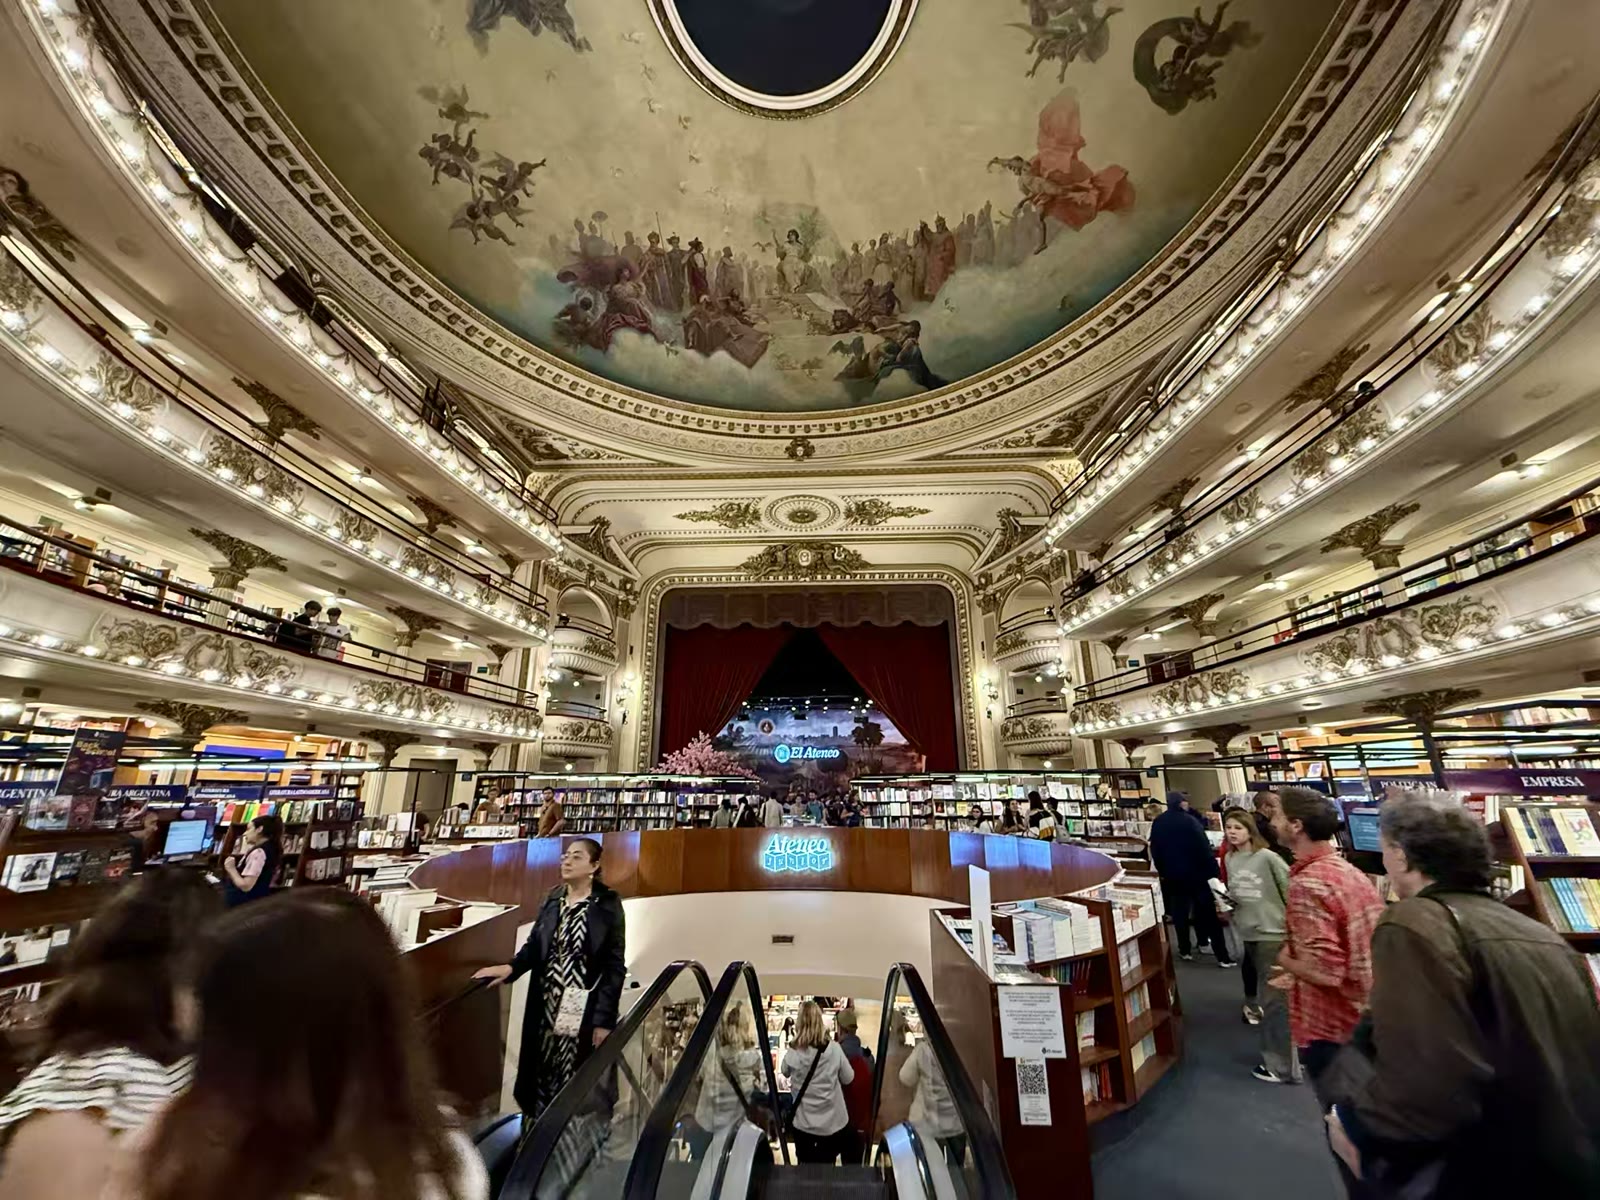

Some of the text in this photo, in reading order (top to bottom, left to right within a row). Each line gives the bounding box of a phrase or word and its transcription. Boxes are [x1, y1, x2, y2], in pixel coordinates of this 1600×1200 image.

[790, 746, 840, 759] El Ateneo
[1520, 776, 1585, 787] EMPRESA
[0, 788, 55, 798] GENTINA
[122, 789, 171, 797] ARGENTINA
[766, 833, 828, 853] Ateneo
